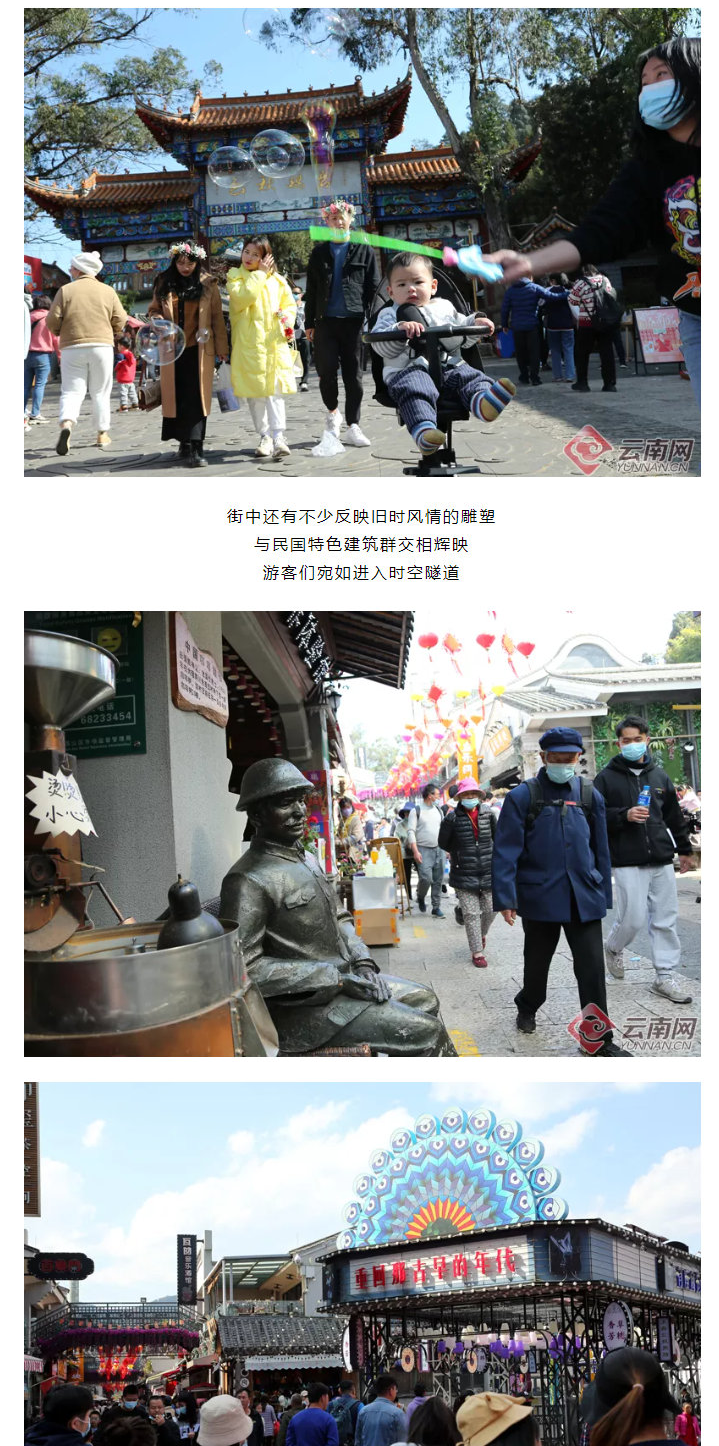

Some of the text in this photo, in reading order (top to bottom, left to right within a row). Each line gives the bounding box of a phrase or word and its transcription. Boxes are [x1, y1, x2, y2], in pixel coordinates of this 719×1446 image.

[355, 1247, 516, 1290] 重回那古早的年代
